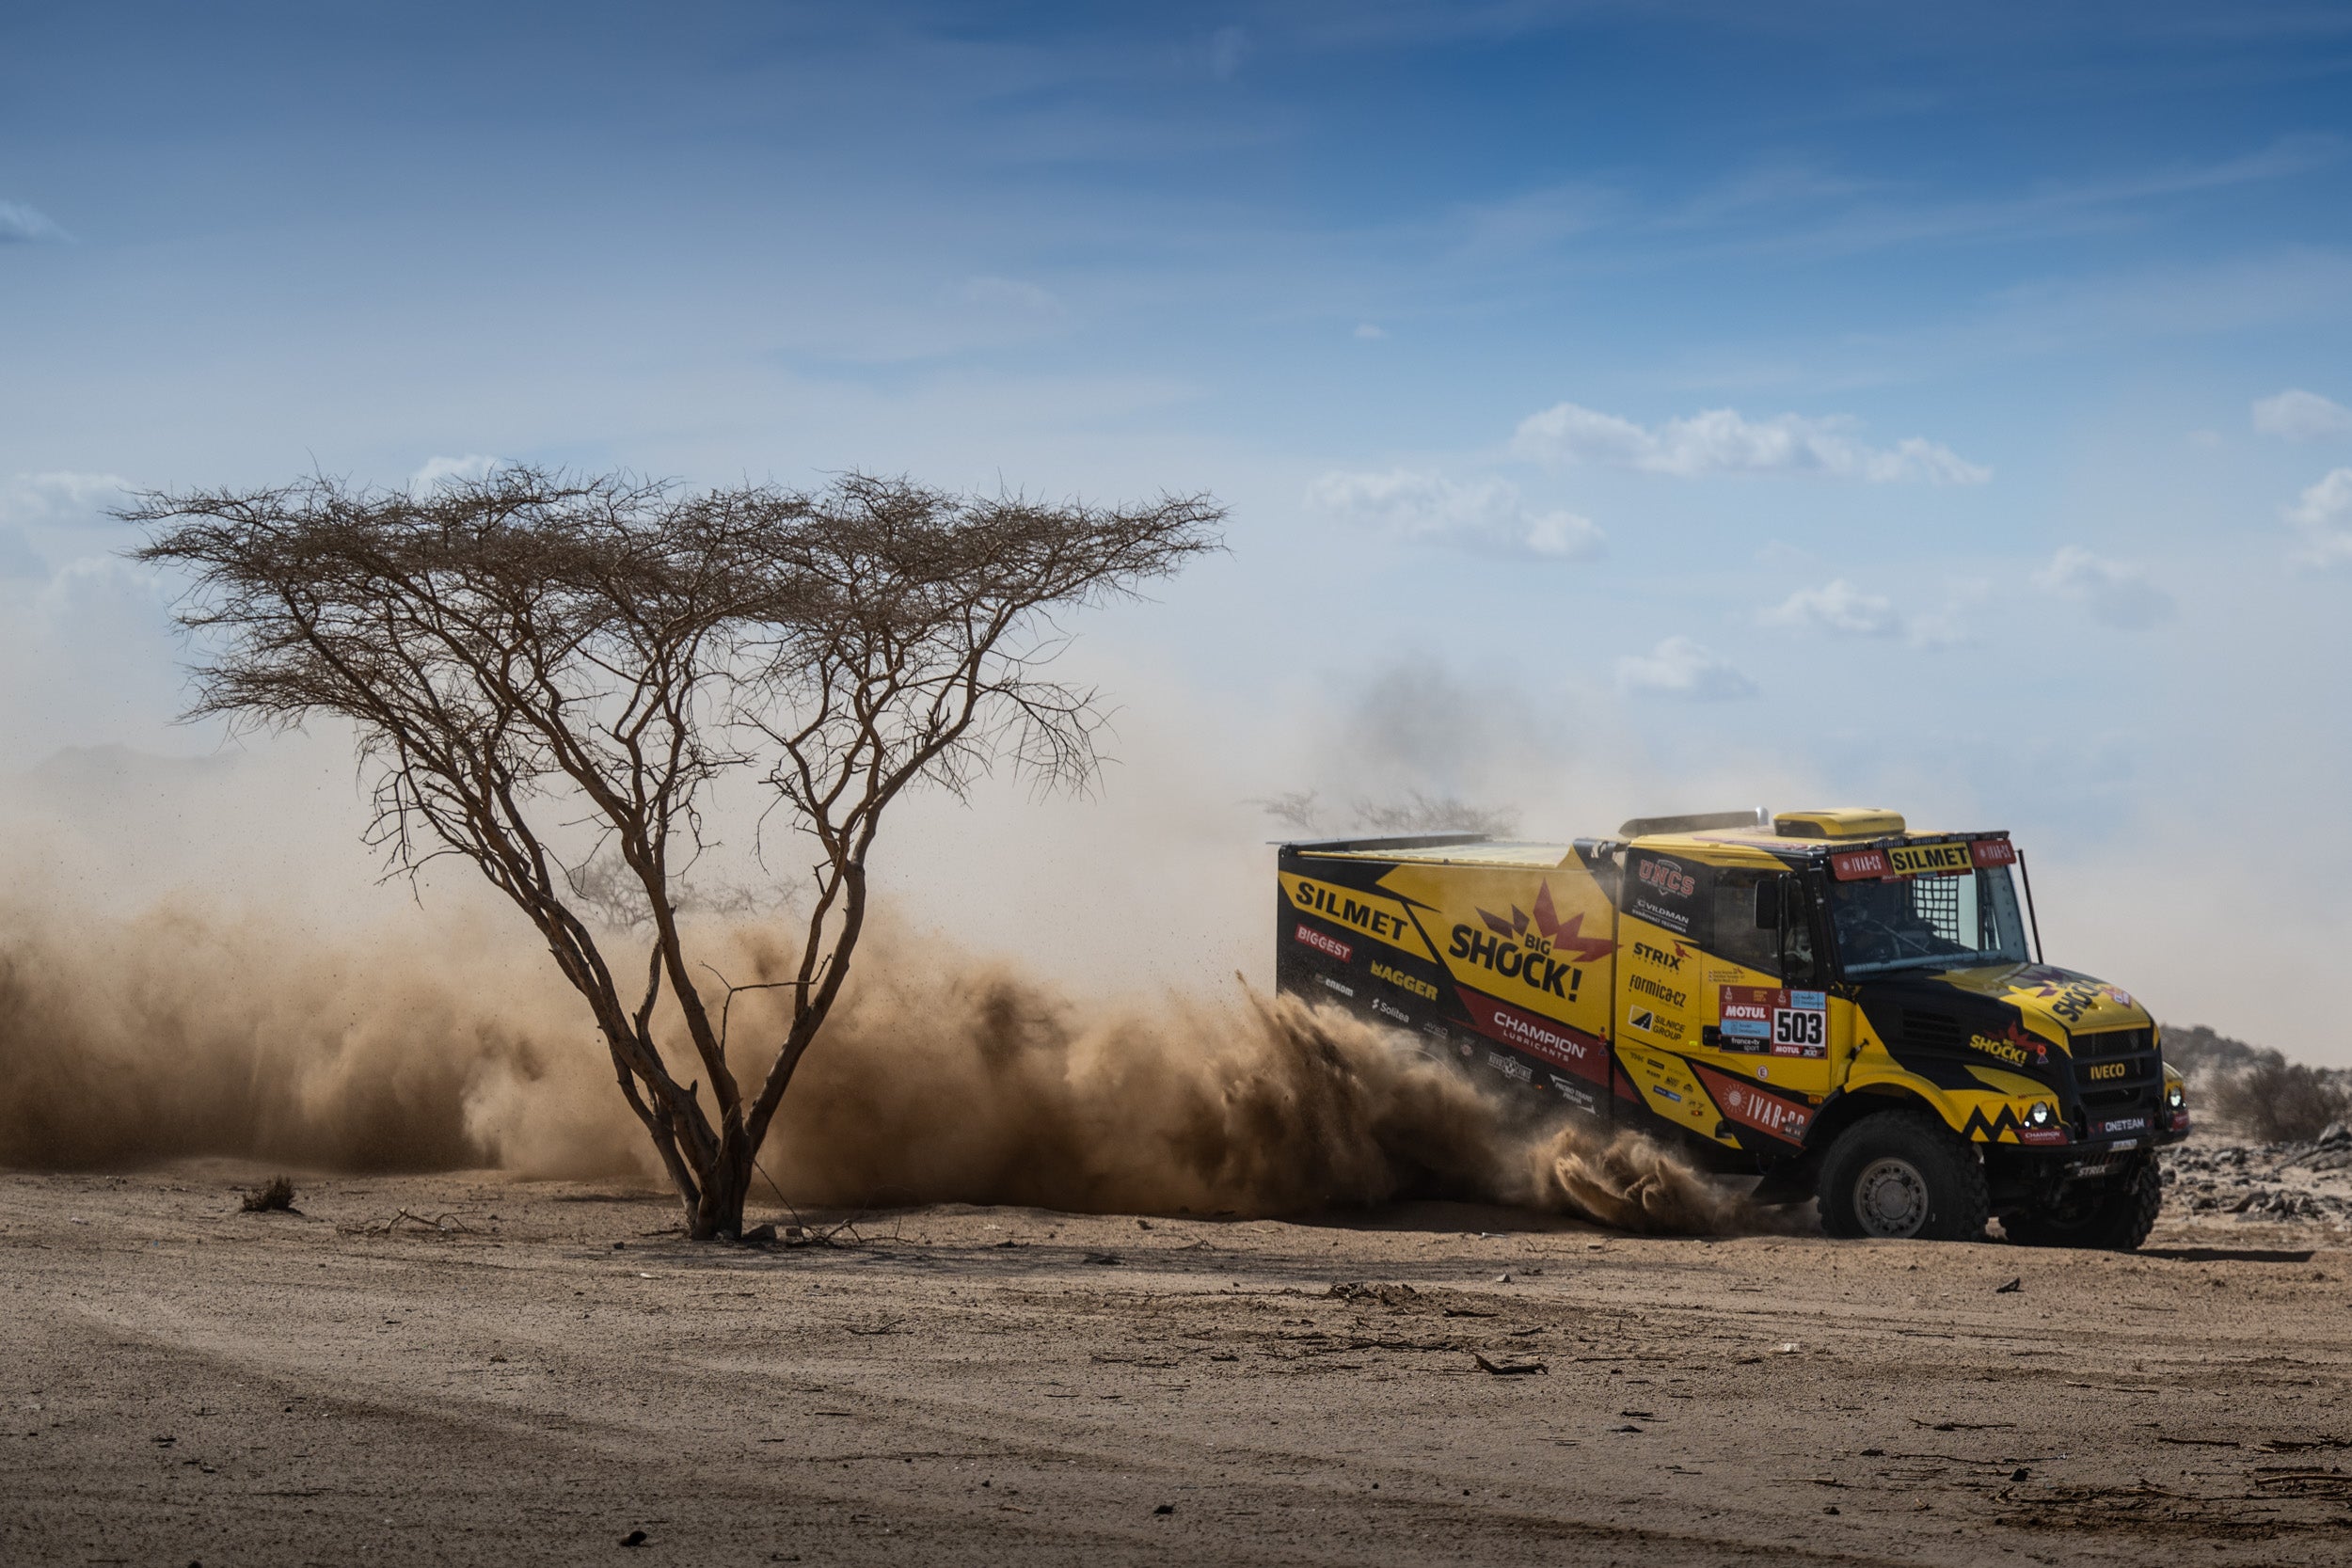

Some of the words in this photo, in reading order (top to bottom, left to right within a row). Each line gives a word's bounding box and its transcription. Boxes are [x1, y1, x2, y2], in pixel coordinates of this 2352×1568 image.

[1892, 847, 1969, 871] SILMET
[1639, 859, 1695, 895] UNCS
[1295, 881, 1408, 941] SILMET
[1297, 927, 1350, 958] BIGGEST
[1524, 933, 1551, 956] BIG
[1448, 924, 1583, 1003] SHOCK!
[1633, 942, 1681, 971] STRIX
[1380, 1002, 1409, 1023] Solitea
[1654, 1015, 1686, 1033] SILNICE
[1725, 1005, 1766, 1019] MOTUL
[1493, 1011, 1585, 1059] CHAMPION
[1653, 1025, 1682, 1040] GROUP
[1777, 1011, 1822, 1045] 503
[1502, 1029, 1569, 1063] LUBRICANTS
[1775, 1045, 1801, 1054] MOTUL
[1970, 1035, 2028, 1065] SHOCK!
[2090, 1063, 2126, 1080] IVECO
[2106, 1117, 2145, 1132] ONETEAM
[2077, 1164, 2107, 1177] STRIX
